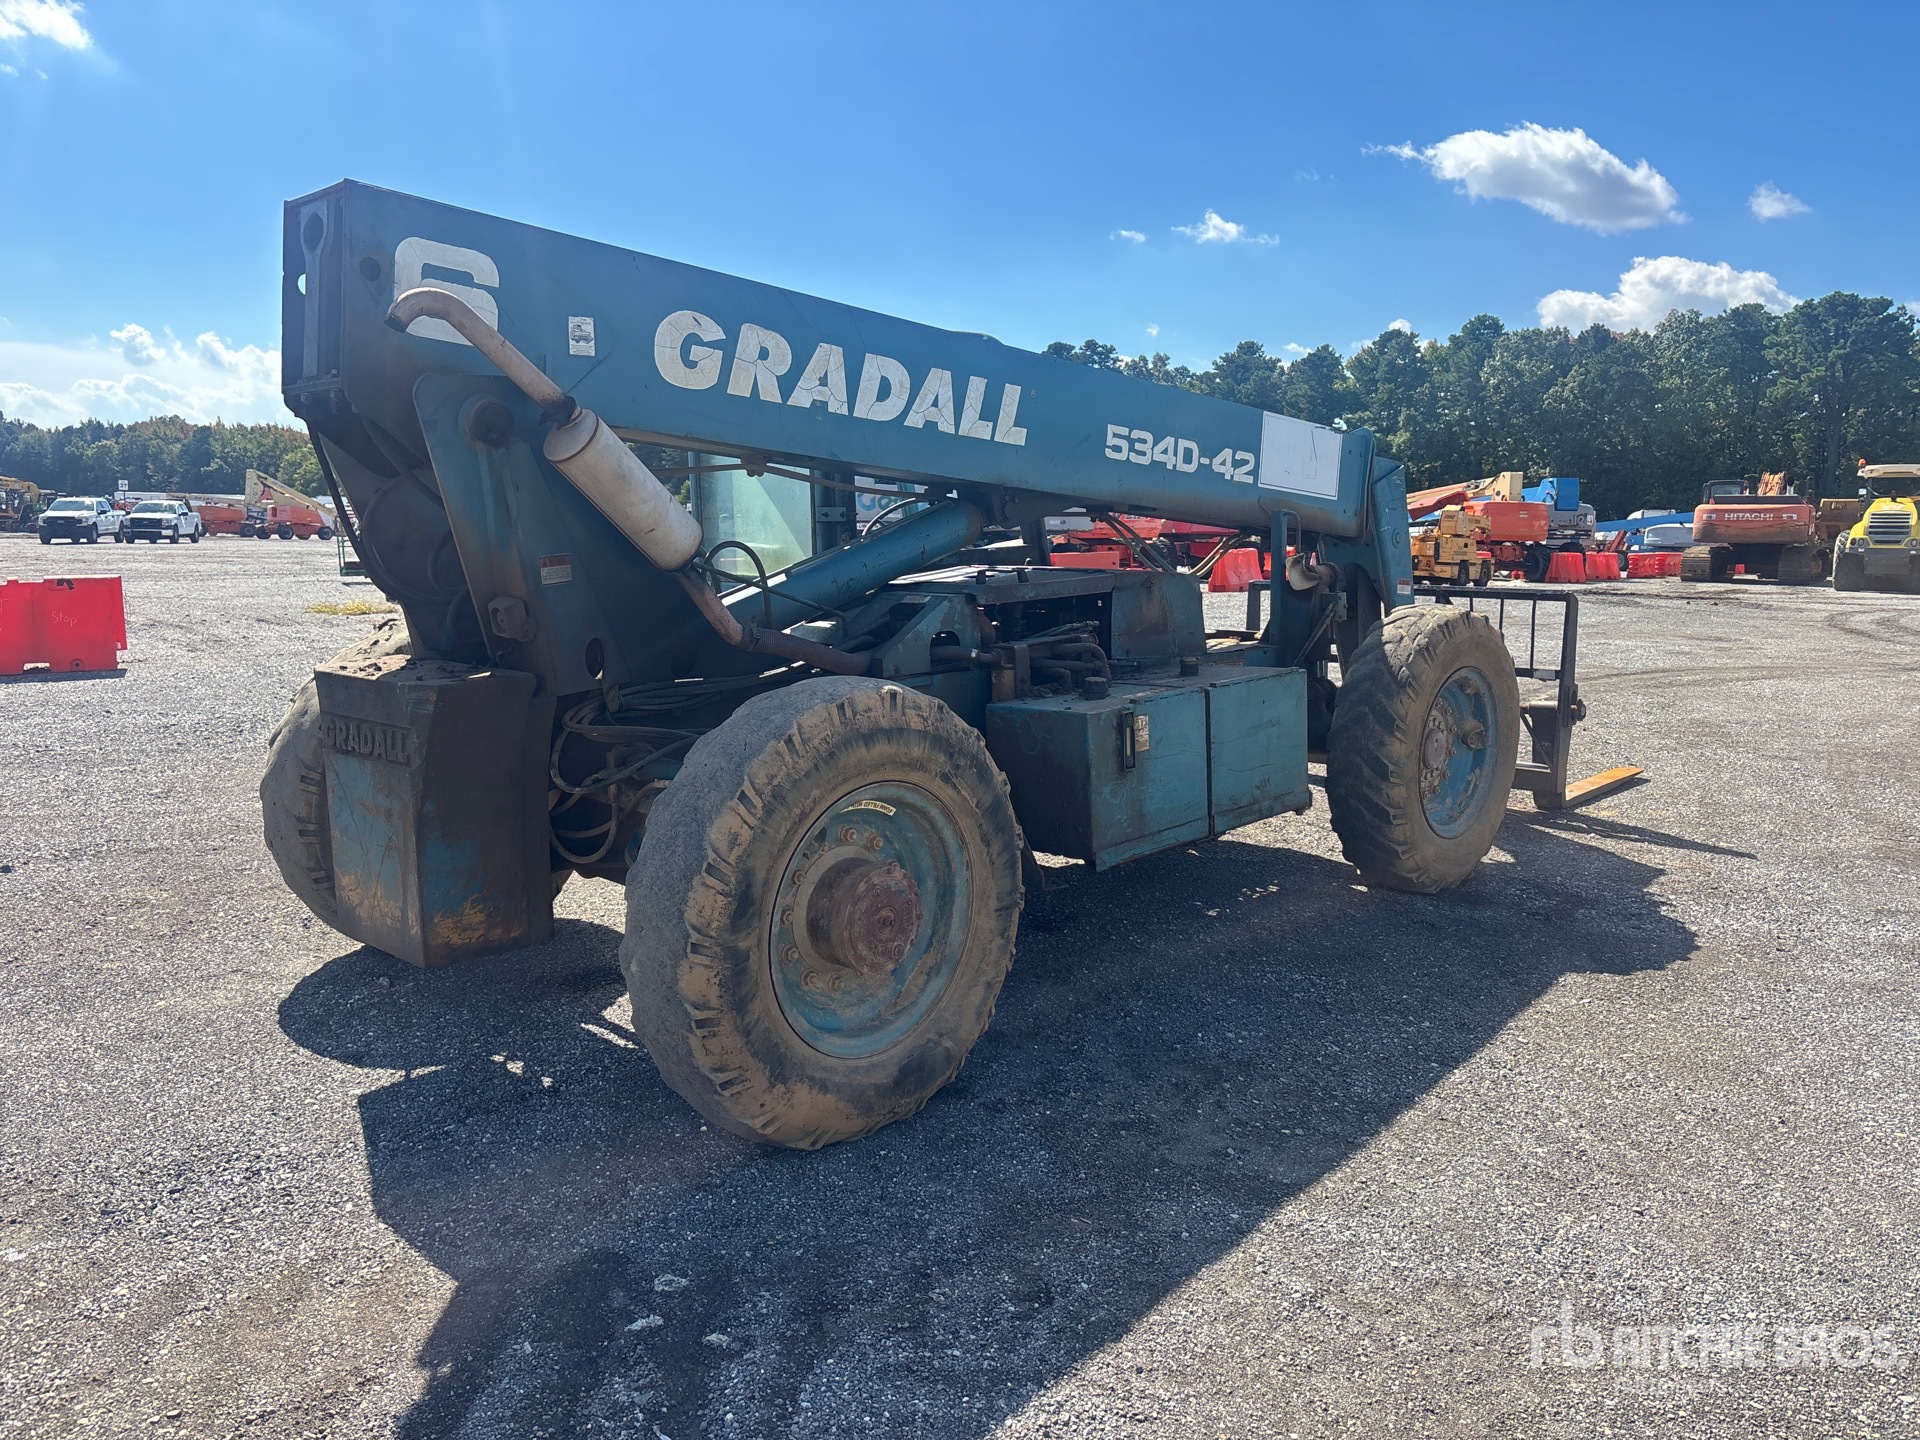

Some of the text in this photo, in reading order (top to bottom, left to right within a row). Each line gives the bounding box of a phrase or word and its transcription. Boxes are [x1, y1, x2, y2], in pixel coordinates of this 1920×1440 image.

[394, 236, 501, 346] 6
[654, 310, 1028, 447] GRADALL
[1104, 423, 1256, 484] 534D-42
[1724, 512, 1774, 521] HITACHI
[51, 610, 77, 627] Stop
[321, 718, 410, 766] GRADALL
